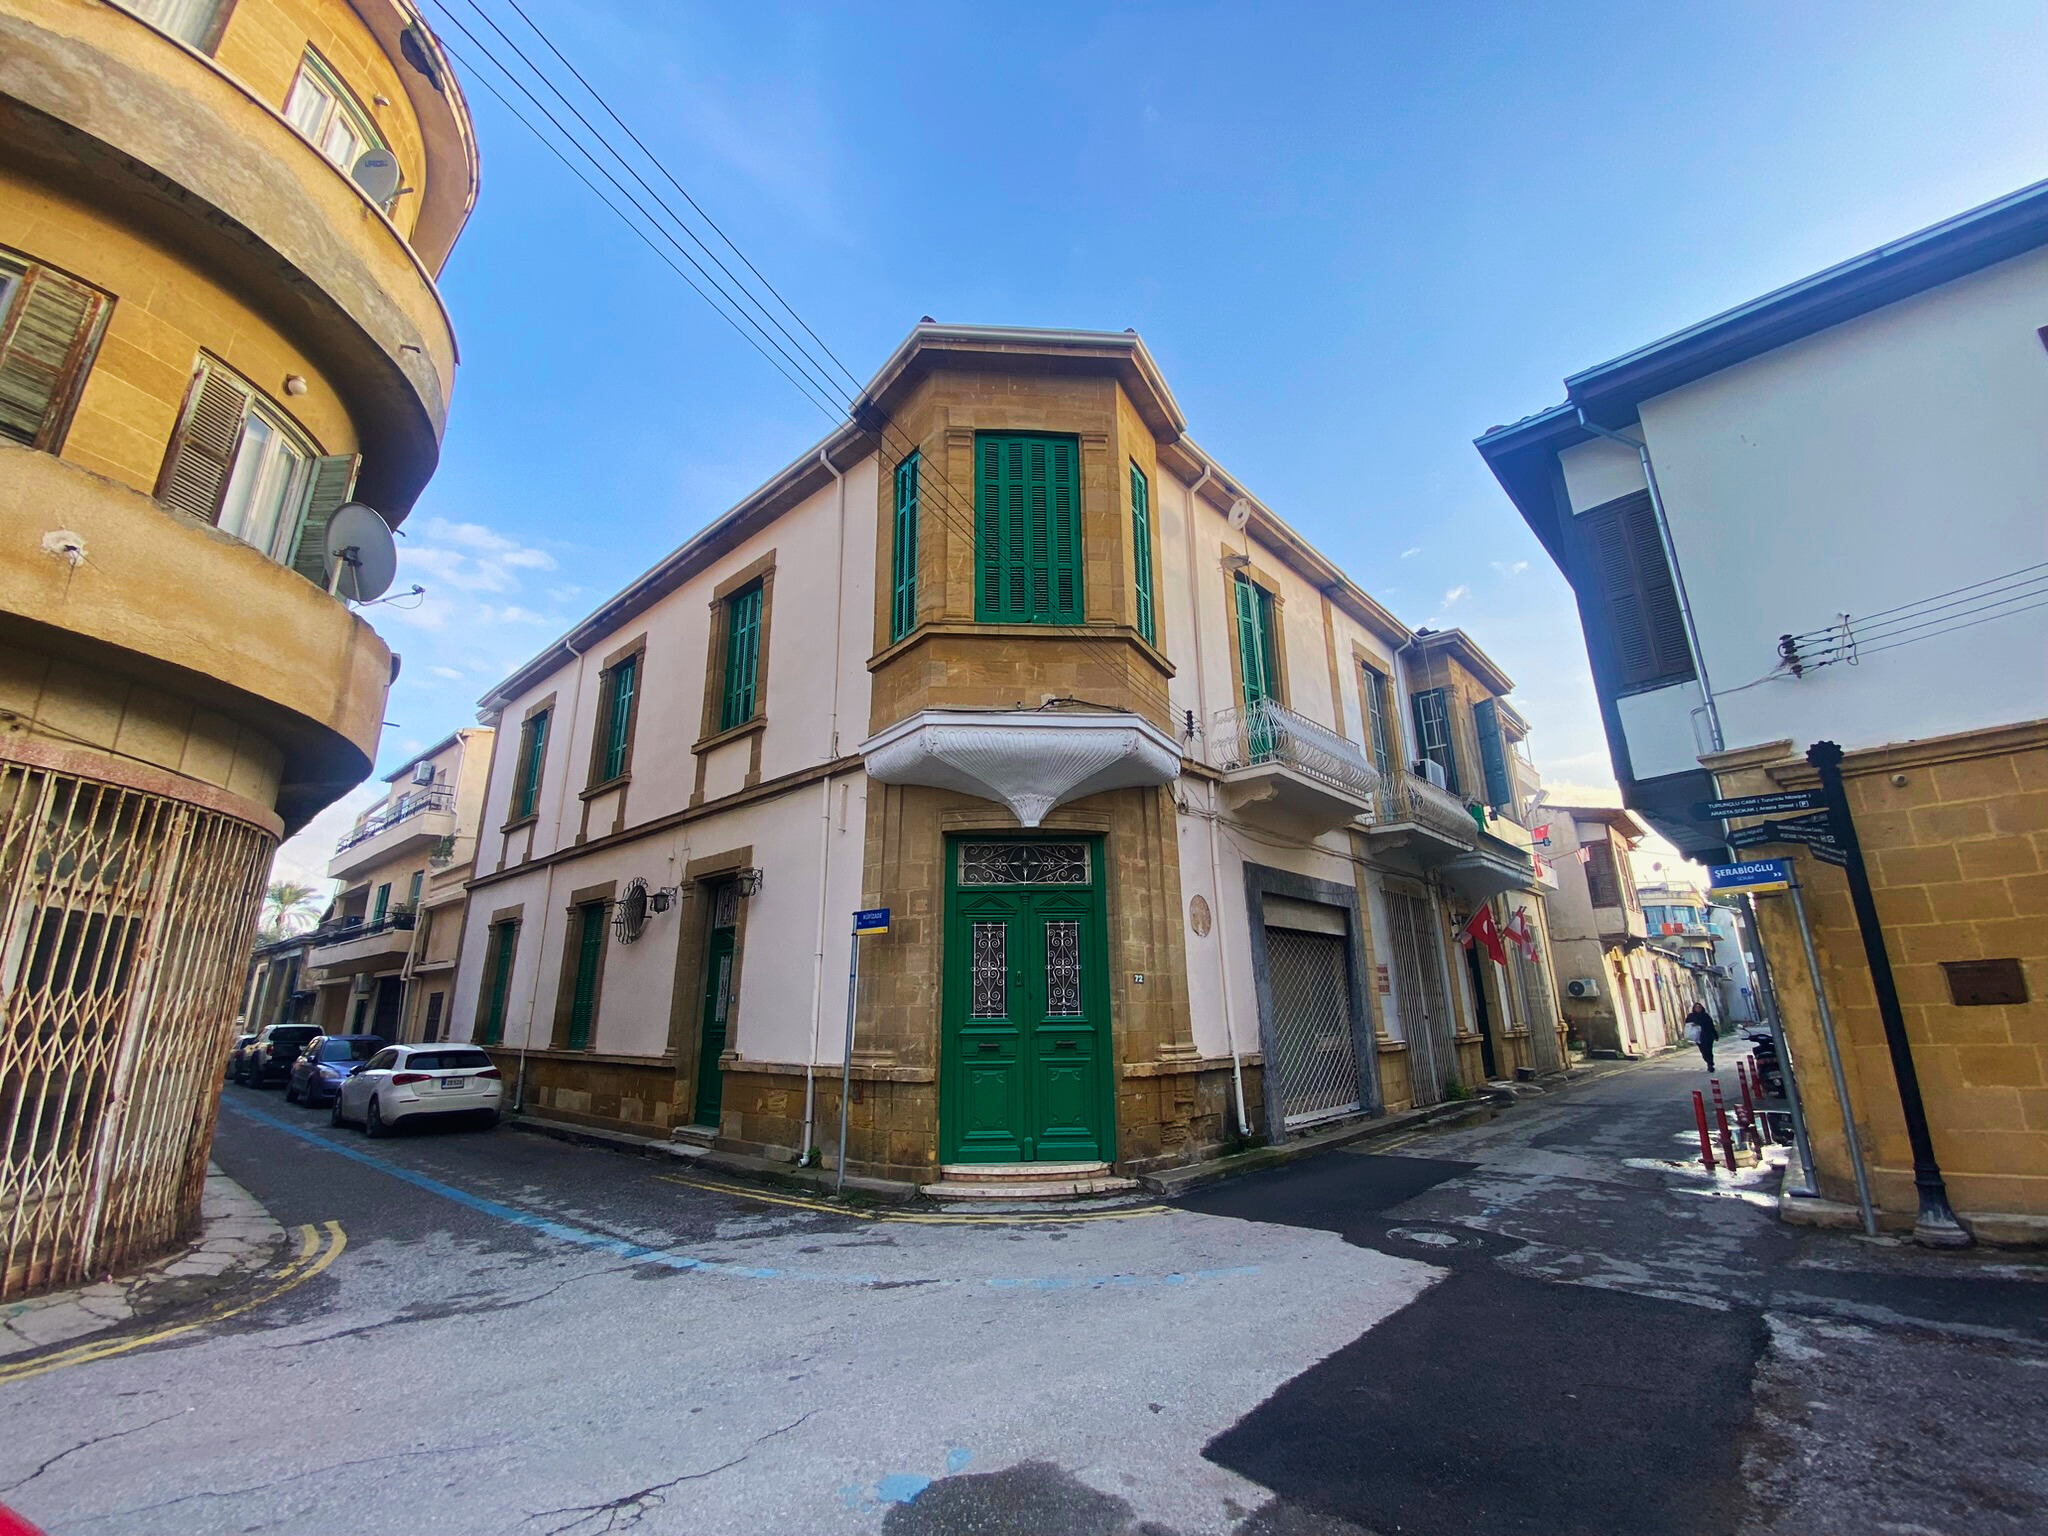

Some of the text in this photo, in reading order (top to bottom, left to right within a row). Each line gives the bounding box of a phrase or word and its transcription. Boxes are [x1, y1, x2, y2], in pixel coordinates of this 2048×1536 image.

[1711, 809, 1734, 817] ARASTA
[1714, 863, 1774, 879] ŞERABİOĞLU
[1134, 974, 1144, 982] 72
